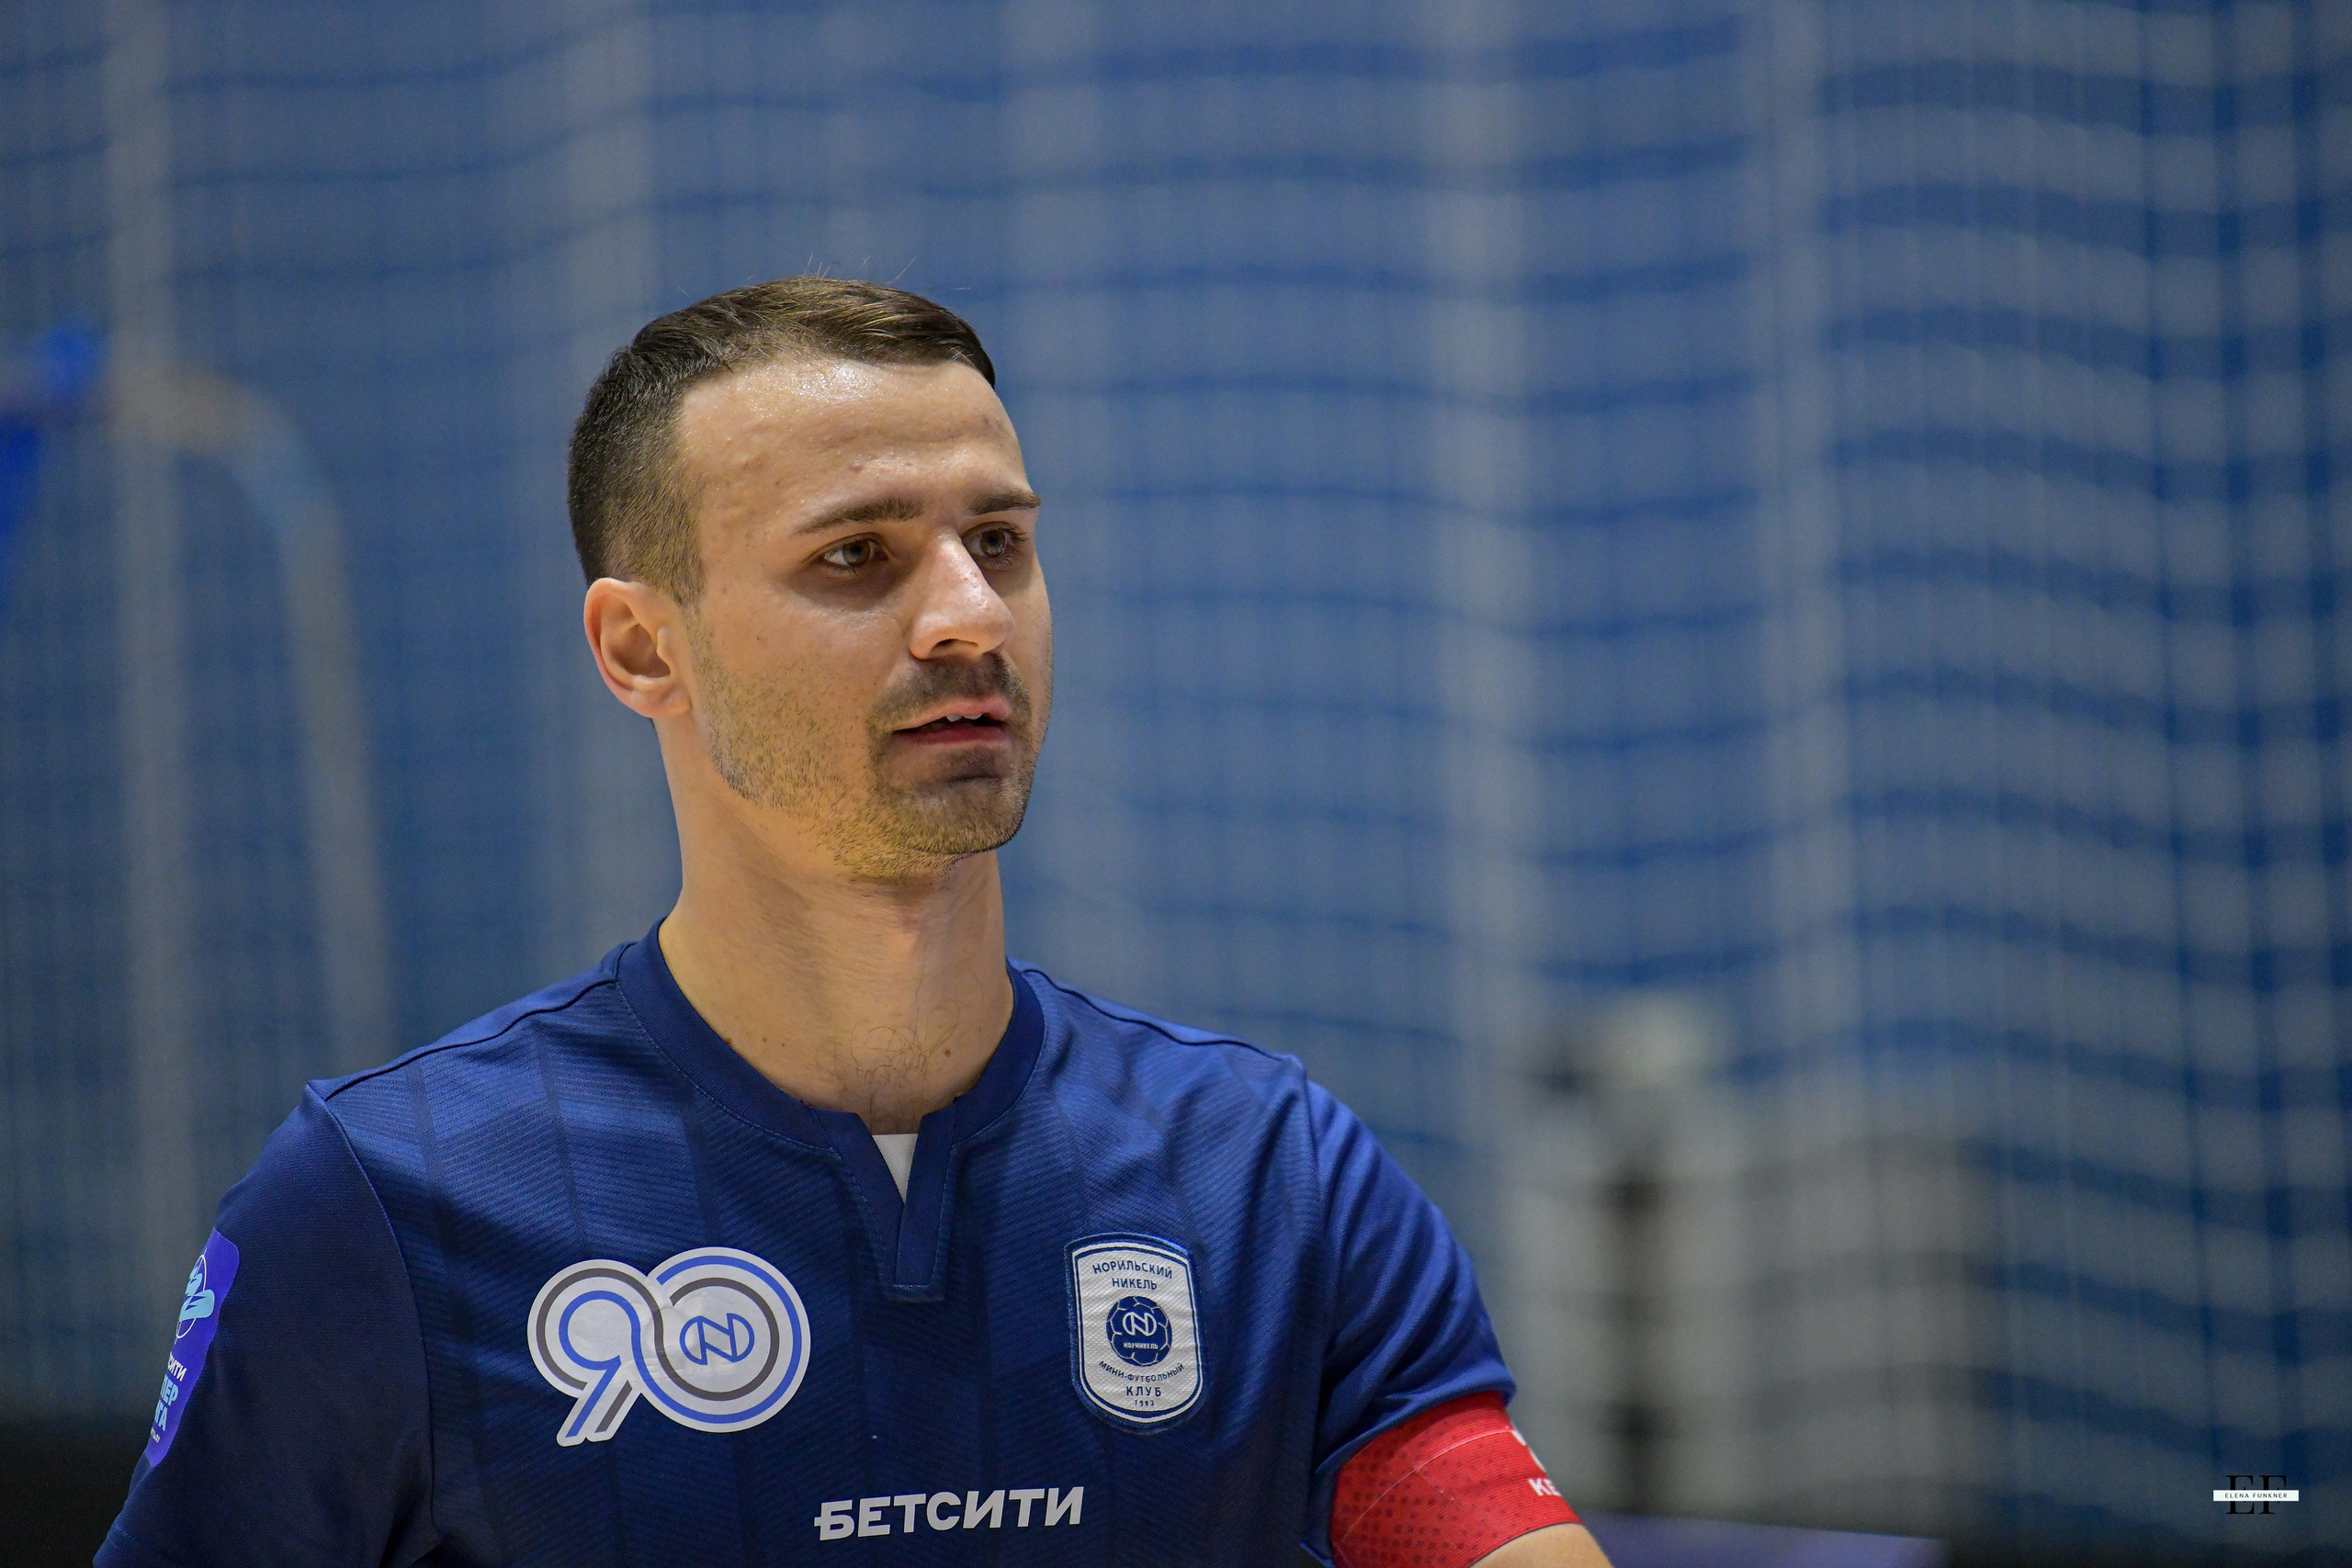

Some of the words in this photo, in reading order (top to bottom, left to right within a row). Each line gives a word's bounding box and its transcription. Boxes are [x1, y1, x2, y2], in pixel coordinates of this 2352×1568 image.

[1092, 1259, 1173, 1280] НОРИЛЬСКИЙ
[1112, 1277, 1158, 1291] НИКЕЛЬ
[1123, 1342, 1159, 1350] НОРНИКЕЛЬ
[167, 1351, 187, 1382] СИТИ
[1098, 1360, 1185, 1383] МИНИ-ФУТБОЛЬНЫЙ
[1125, 1386, 1162, 1397] КЛУБ
[814, 1486, 1084, 1541] БЕТСИТИ
